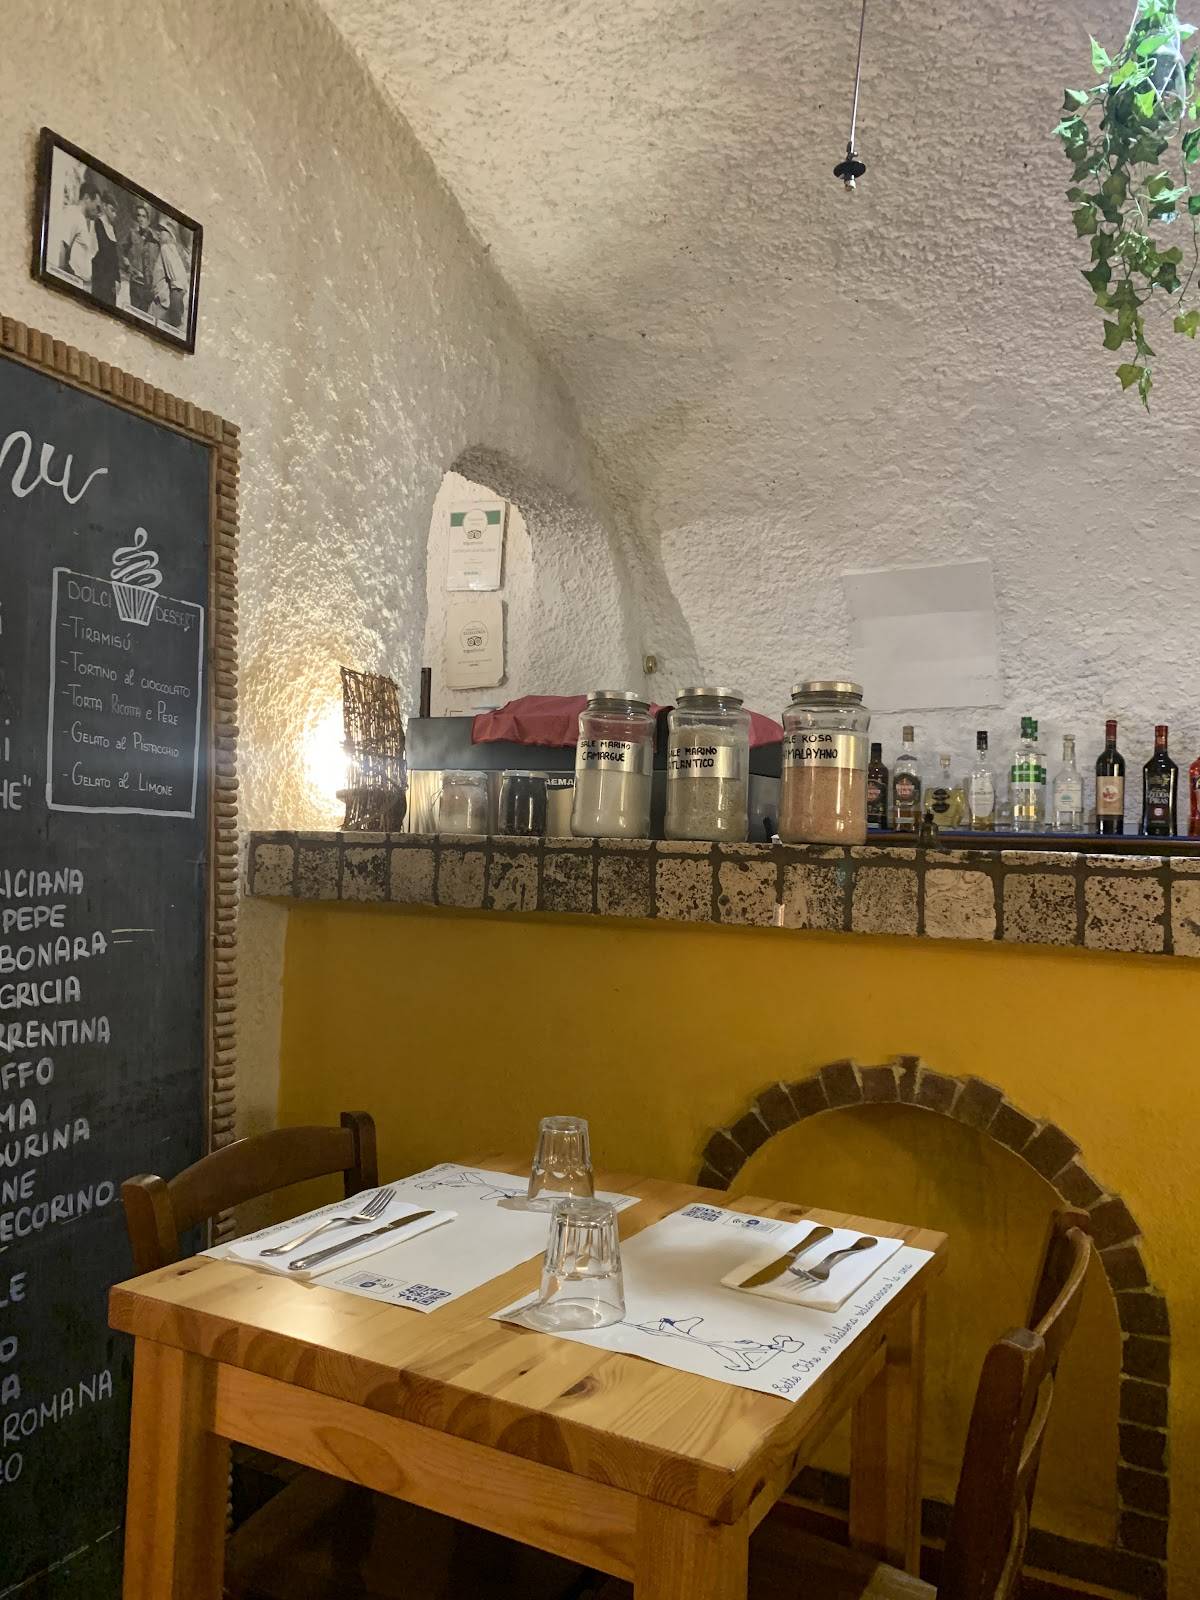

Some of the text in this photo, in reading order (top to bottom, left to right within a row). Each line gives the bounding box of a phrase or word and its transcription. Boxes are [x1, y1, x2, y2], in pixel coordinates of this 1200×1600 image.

[67, 580, 112, 608] DOLCI
[123, 668, 135, 686] al
[157, 700, 180, 726] PERE
[115, 736, 127, 750] al
[580, 740, 631, 750] SALE MARINO
[685, 746, 718, 756] MARINO
[802, 734, 833, 744] ROSA
[581, 751, 625, 762] CAMARGUE
[118, 771, 129, 789] al
[138, 773, 173, 796] LIMONE
[2, 904, 67, 935] PEPE
[0, 975, 81, 1010] GRICIA
[1, 1057, 55, 1090] FFO
[2, 1169, 37, 1205] NE
[3, 1369, 113, 1448] ROMANA
